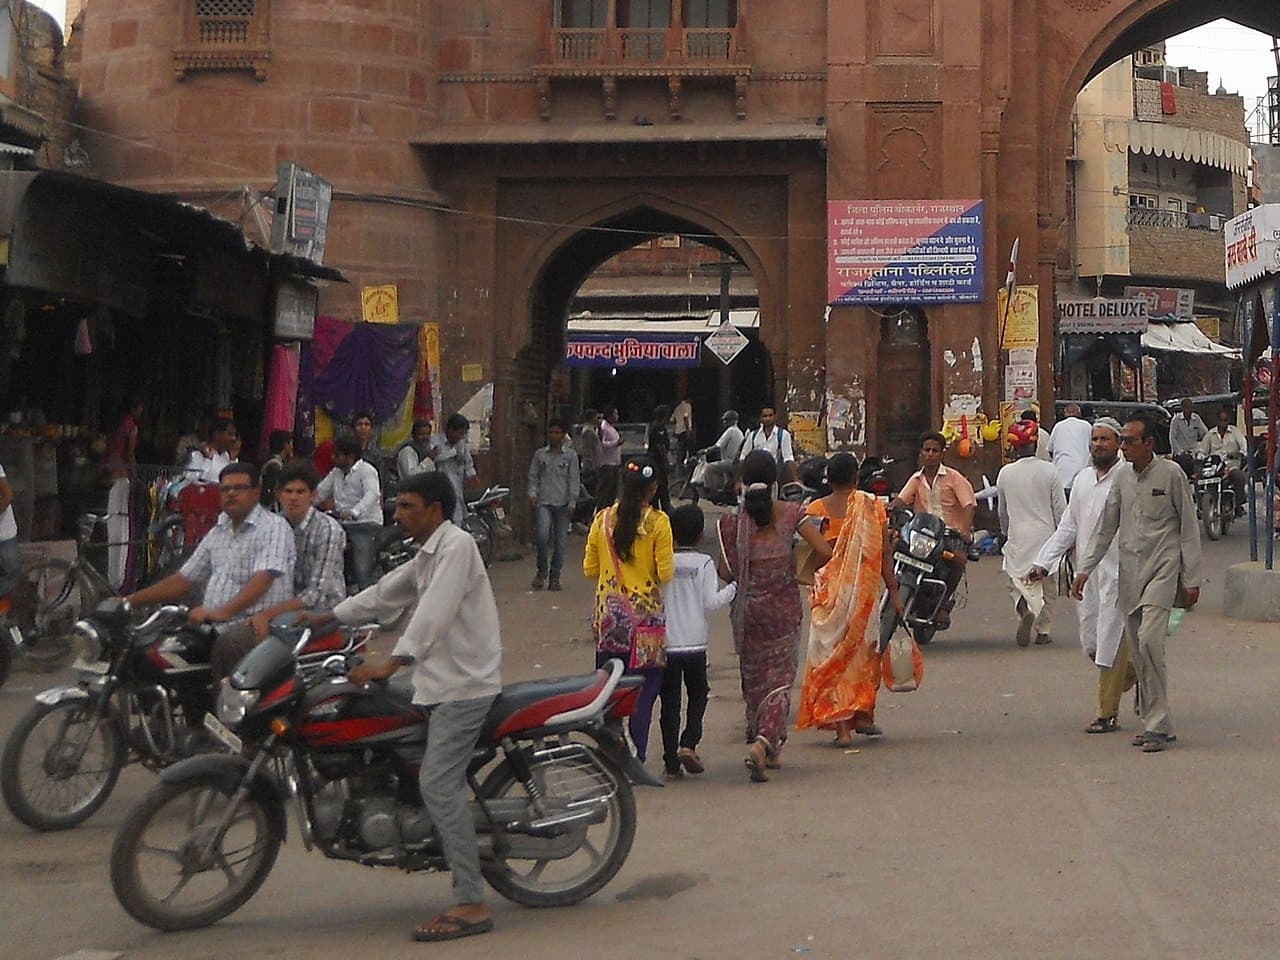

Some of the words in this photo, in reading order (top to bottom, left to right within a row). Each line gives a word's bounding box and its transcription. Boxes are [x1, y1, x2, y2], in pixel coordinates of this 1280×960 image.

[836, 267, 903, 280] राजपूताना
[906, 263, 976, 276] पब्लिसिटी
[1058, 303, 1097, 317] HOTEL
[1098, 302, 1147, 317] DELUXE
[612, 337, 660, 366] भुजिया
[661, 342, 697, 359] वाला
